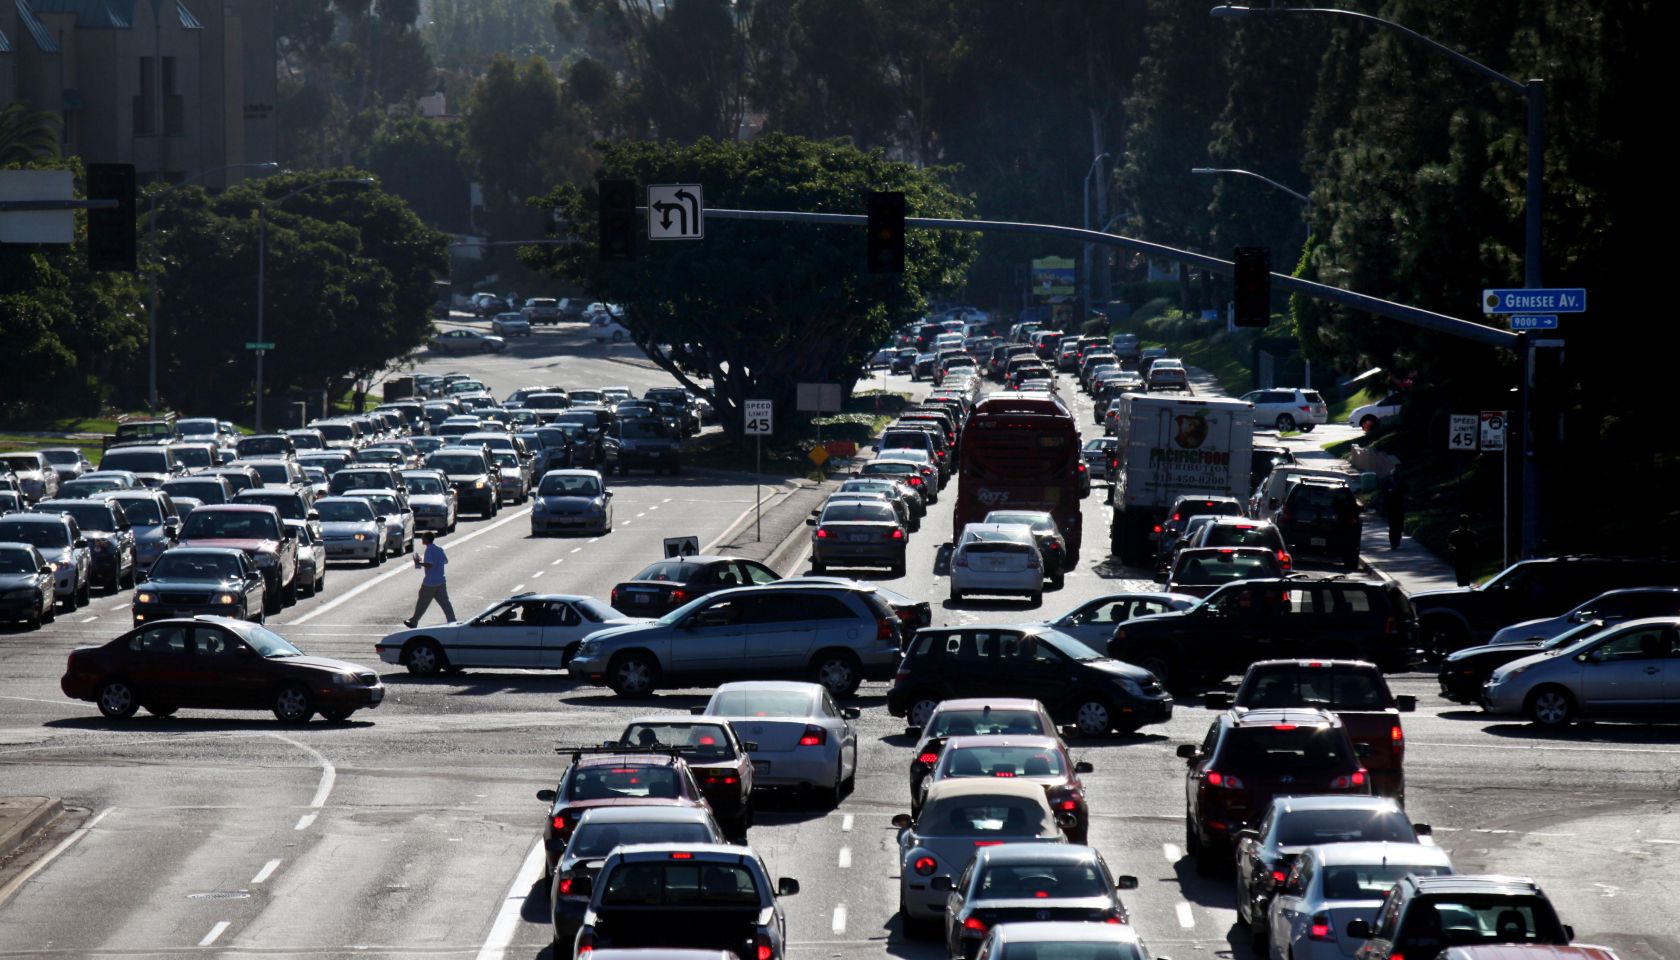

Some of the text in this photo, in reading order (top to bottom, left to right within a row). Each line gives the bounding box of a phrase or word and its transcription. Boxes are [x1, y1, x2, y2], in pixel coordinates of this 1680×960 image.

[1514, 317, 1538, 326] 9000
[747, 419, 769, 432] 45
[1452, 416, 1475, 425] SPEED
[1451, 433, 1473, 446] 45
[977, 488, 1009, 503] MTS
